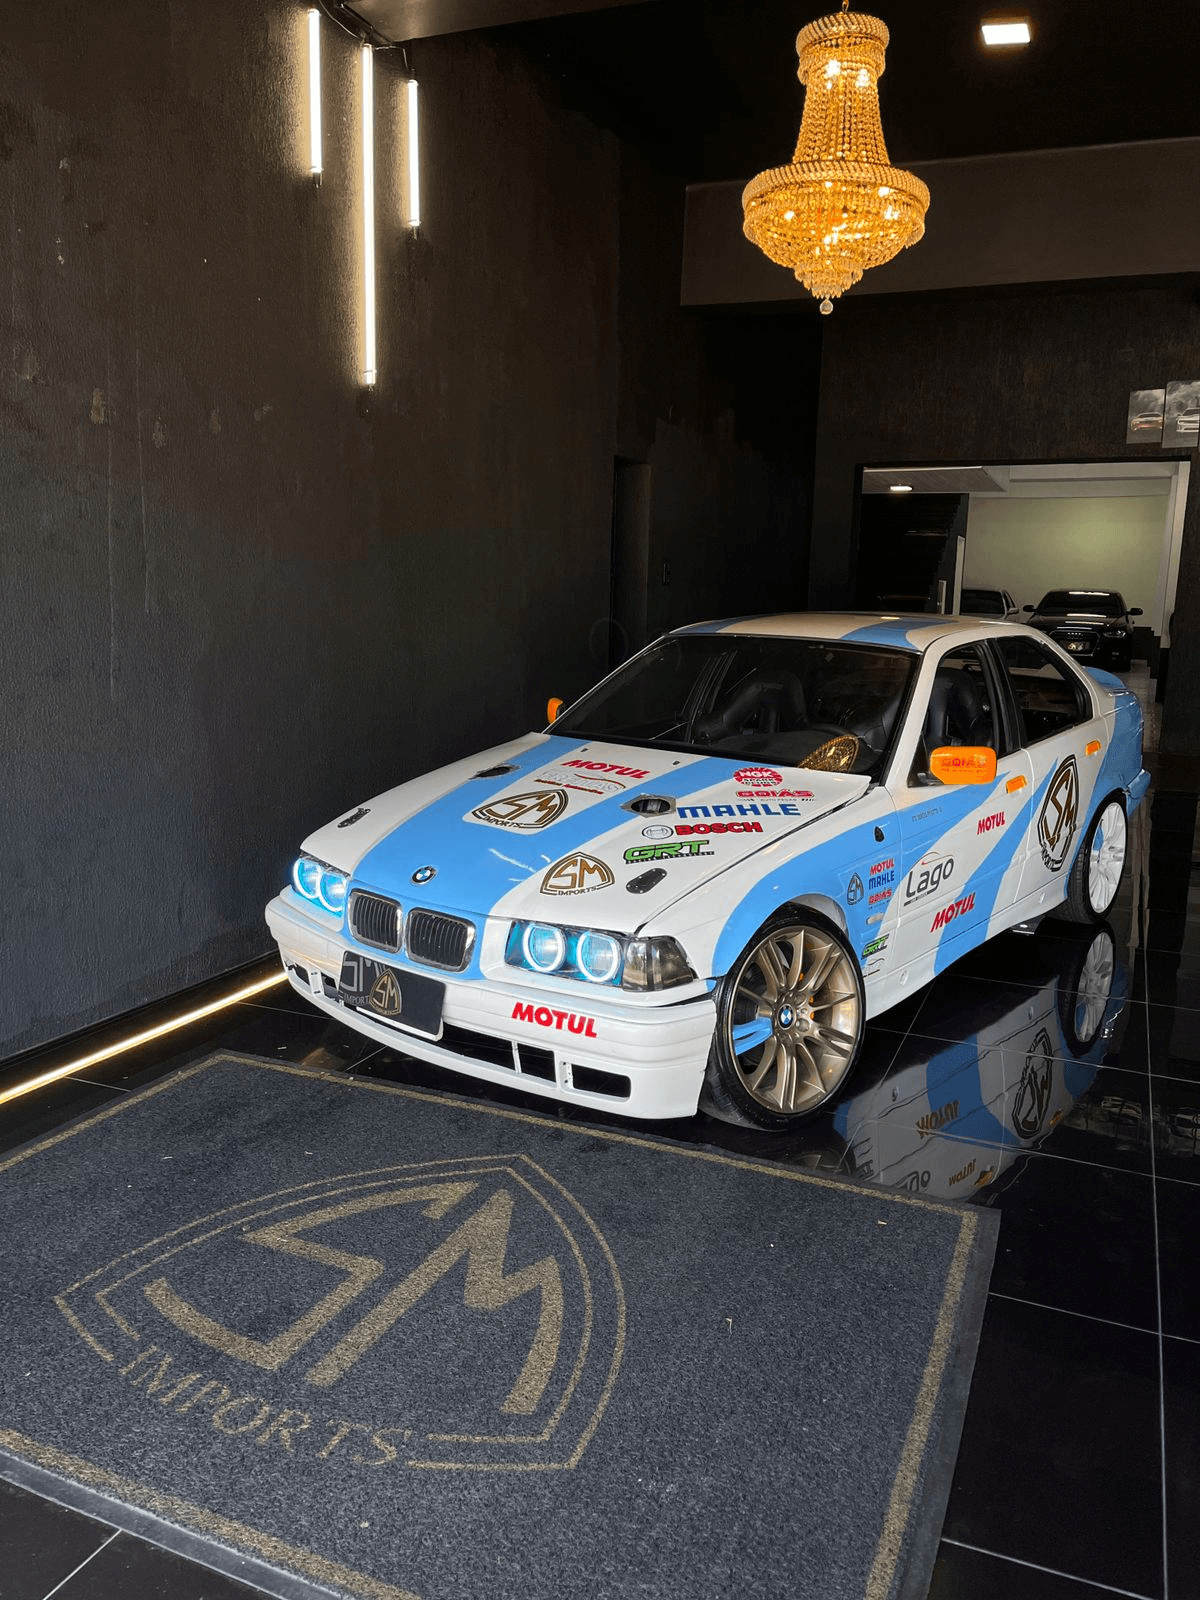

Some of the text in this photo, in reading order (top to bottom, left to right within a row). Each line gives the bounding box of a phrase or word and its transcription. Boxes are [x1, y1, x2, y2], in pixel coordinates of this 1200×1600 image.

[560, 760, 650, 779] MOTUL
[677, 804, 801, 818] MAHLE
[674, 822, 763, 835] BOSCH
[977, 811, 1005, 835] MOTUL
[623, 840, 709, 861] GRT
[549, 858, 607, 889] SM
[869, 858, 895, 876] MOTUL
[868, 870, 895, 890] MAHLE
[557, 886, 598, 896] IMPORTS
[930, 892, 976, 932] MOTUL
[344, 993, 370, 1005] IMPORT
[372, 974, 398, 1010] SM
[511, 1001, 597, 1039] MOTUL
[143, 1181, 564, 1415] SM
[118, 1345, 411, 1466] IMPORTS
